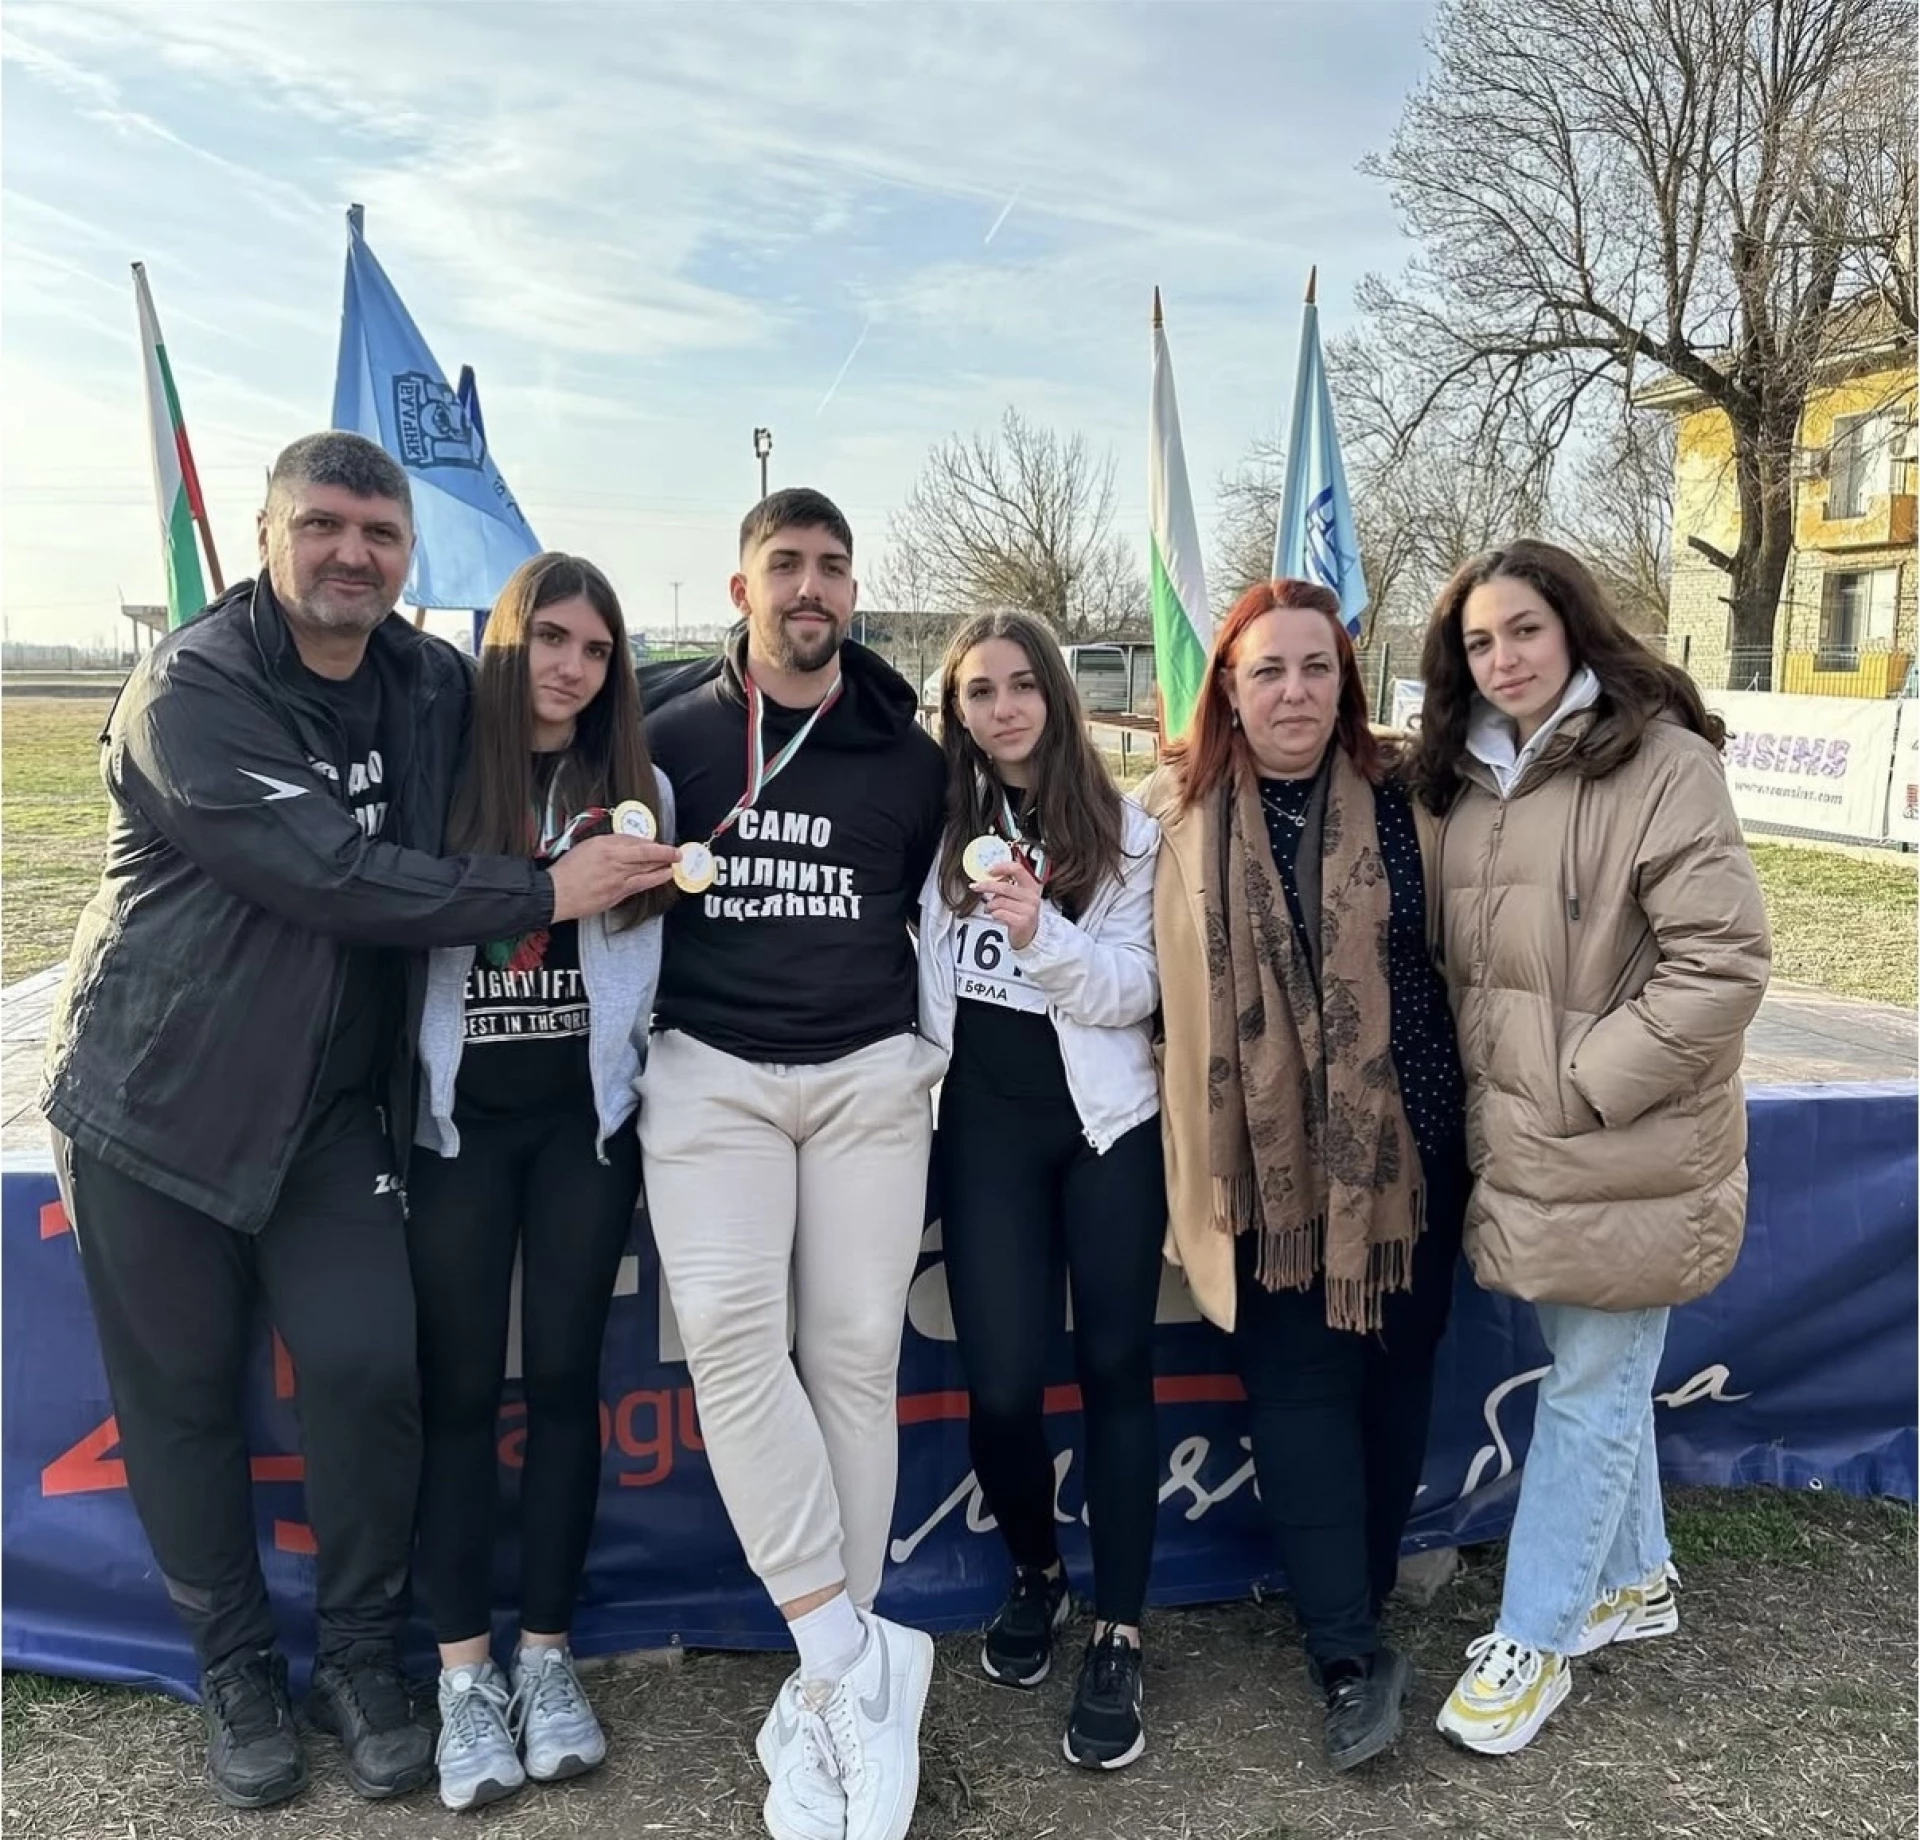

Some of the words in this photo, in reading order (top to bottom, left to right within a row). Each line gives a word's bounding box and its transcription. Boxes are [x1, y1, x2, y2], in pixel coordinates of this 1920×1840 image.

[738, 808, 832, 848] САМО
[712, 855, 855, 897] СИЛНИТЕ
[956, 923, 1022, 978] 16
[965, 980, 1007, 1001] БФЛА
[504, 1014, 521, 1033] IN
[528, 1013, 557, 1031] THE
[559, 1010, 588, 1031] ORL
